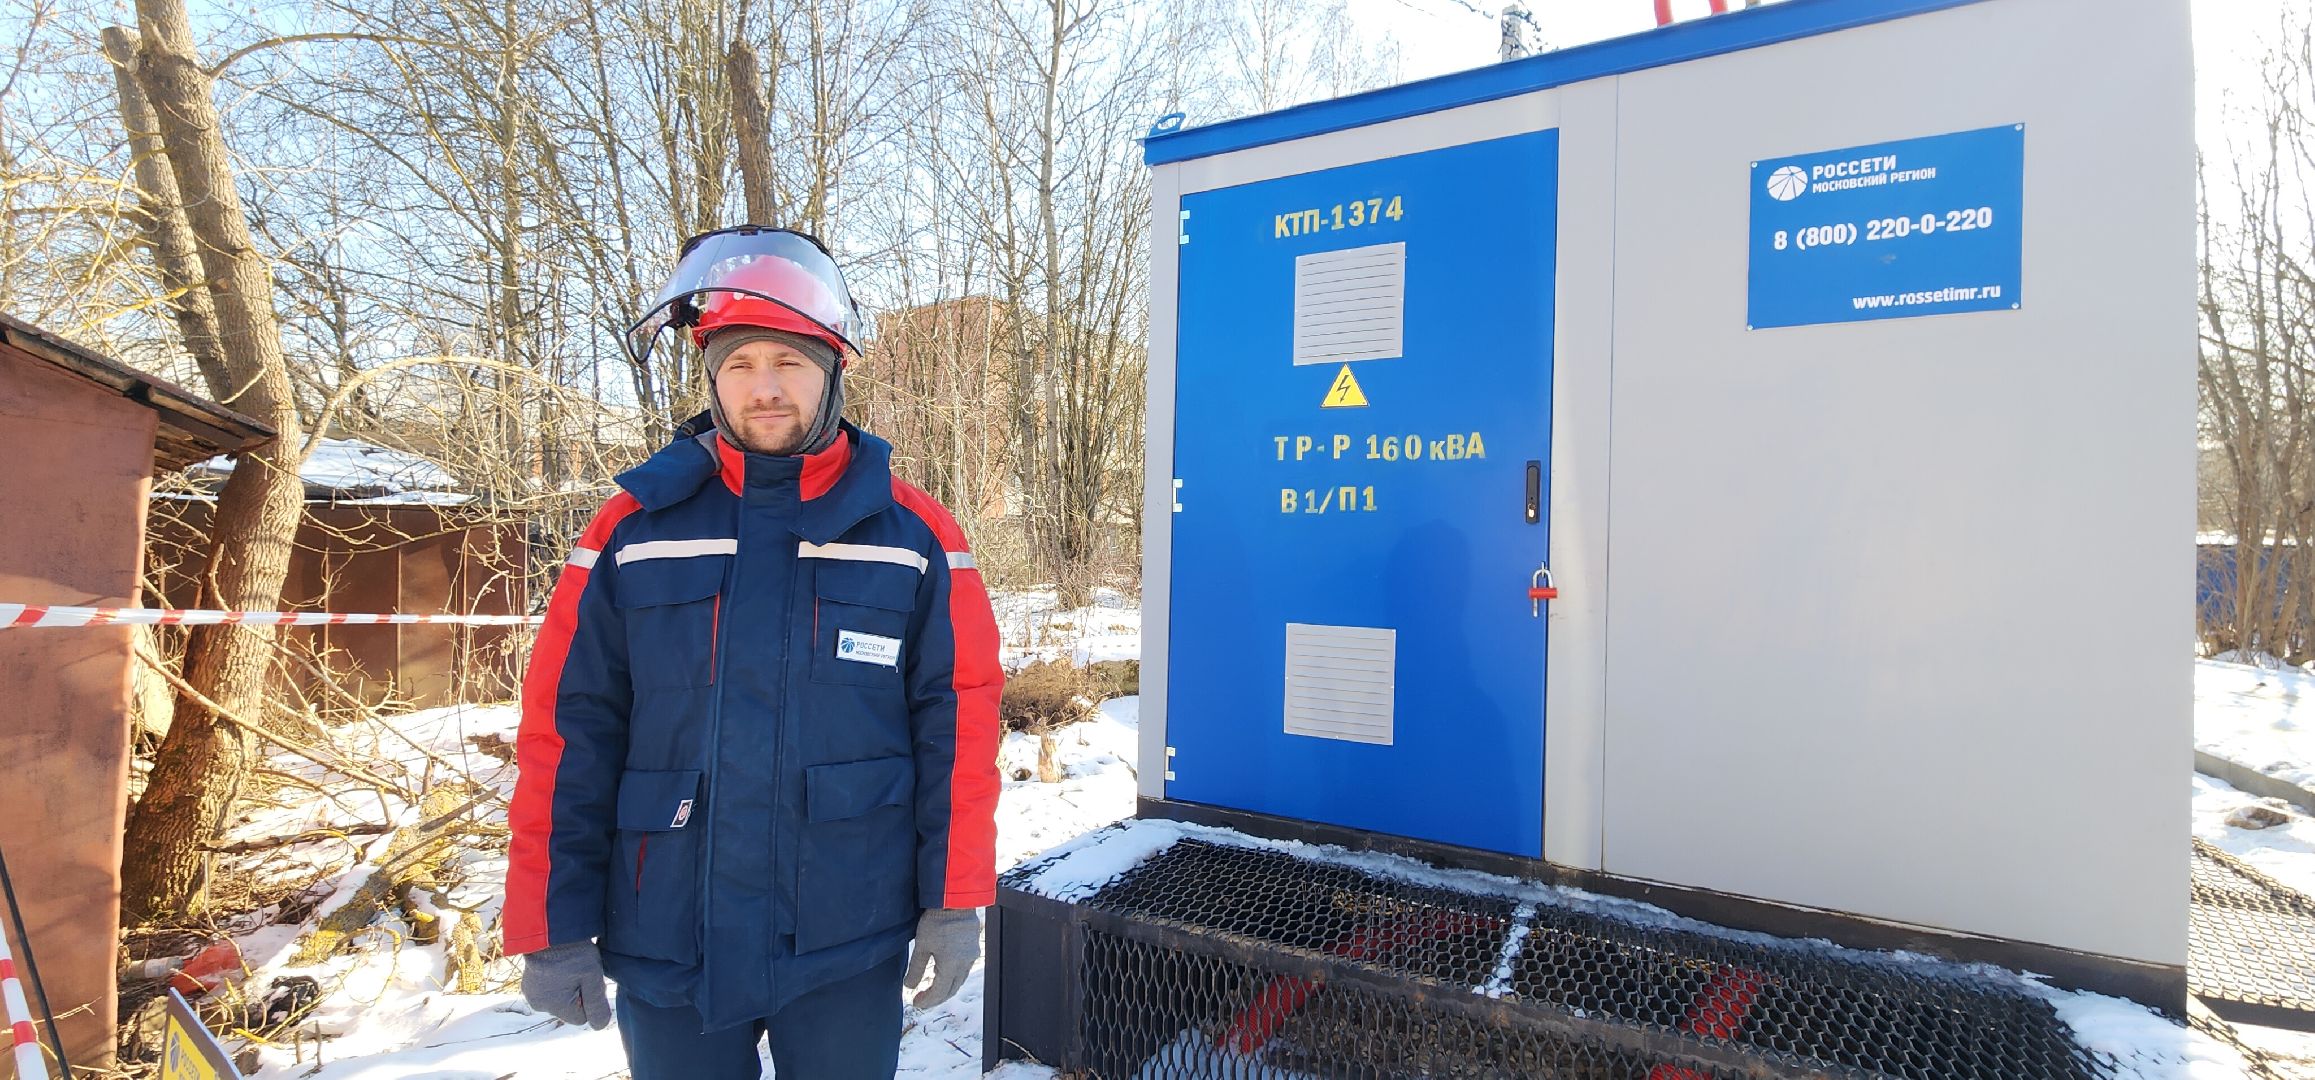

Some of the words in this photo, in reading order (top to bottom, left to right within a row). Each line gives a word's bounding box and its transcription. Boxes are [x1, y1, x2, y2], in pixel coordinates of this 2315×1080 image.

[1812, 154, 1897, 180] РОССЕТИ
[1812, 173, 1887, 193] МОСКОВСКИЙ
[1890, 167, 1936, 184] РЕГИОН
[1274, 195, 1404, 239] КТП-1374
[1774, 230, 1788, 251] 8
[1796, 222, 1858, 251] (800)
[1866, 206, 1993, 241] 220-0-220
[1852, 284, 2001, 310] www.rossetimr.ru
[856, 641, 886, 653] РОССЕТИ
